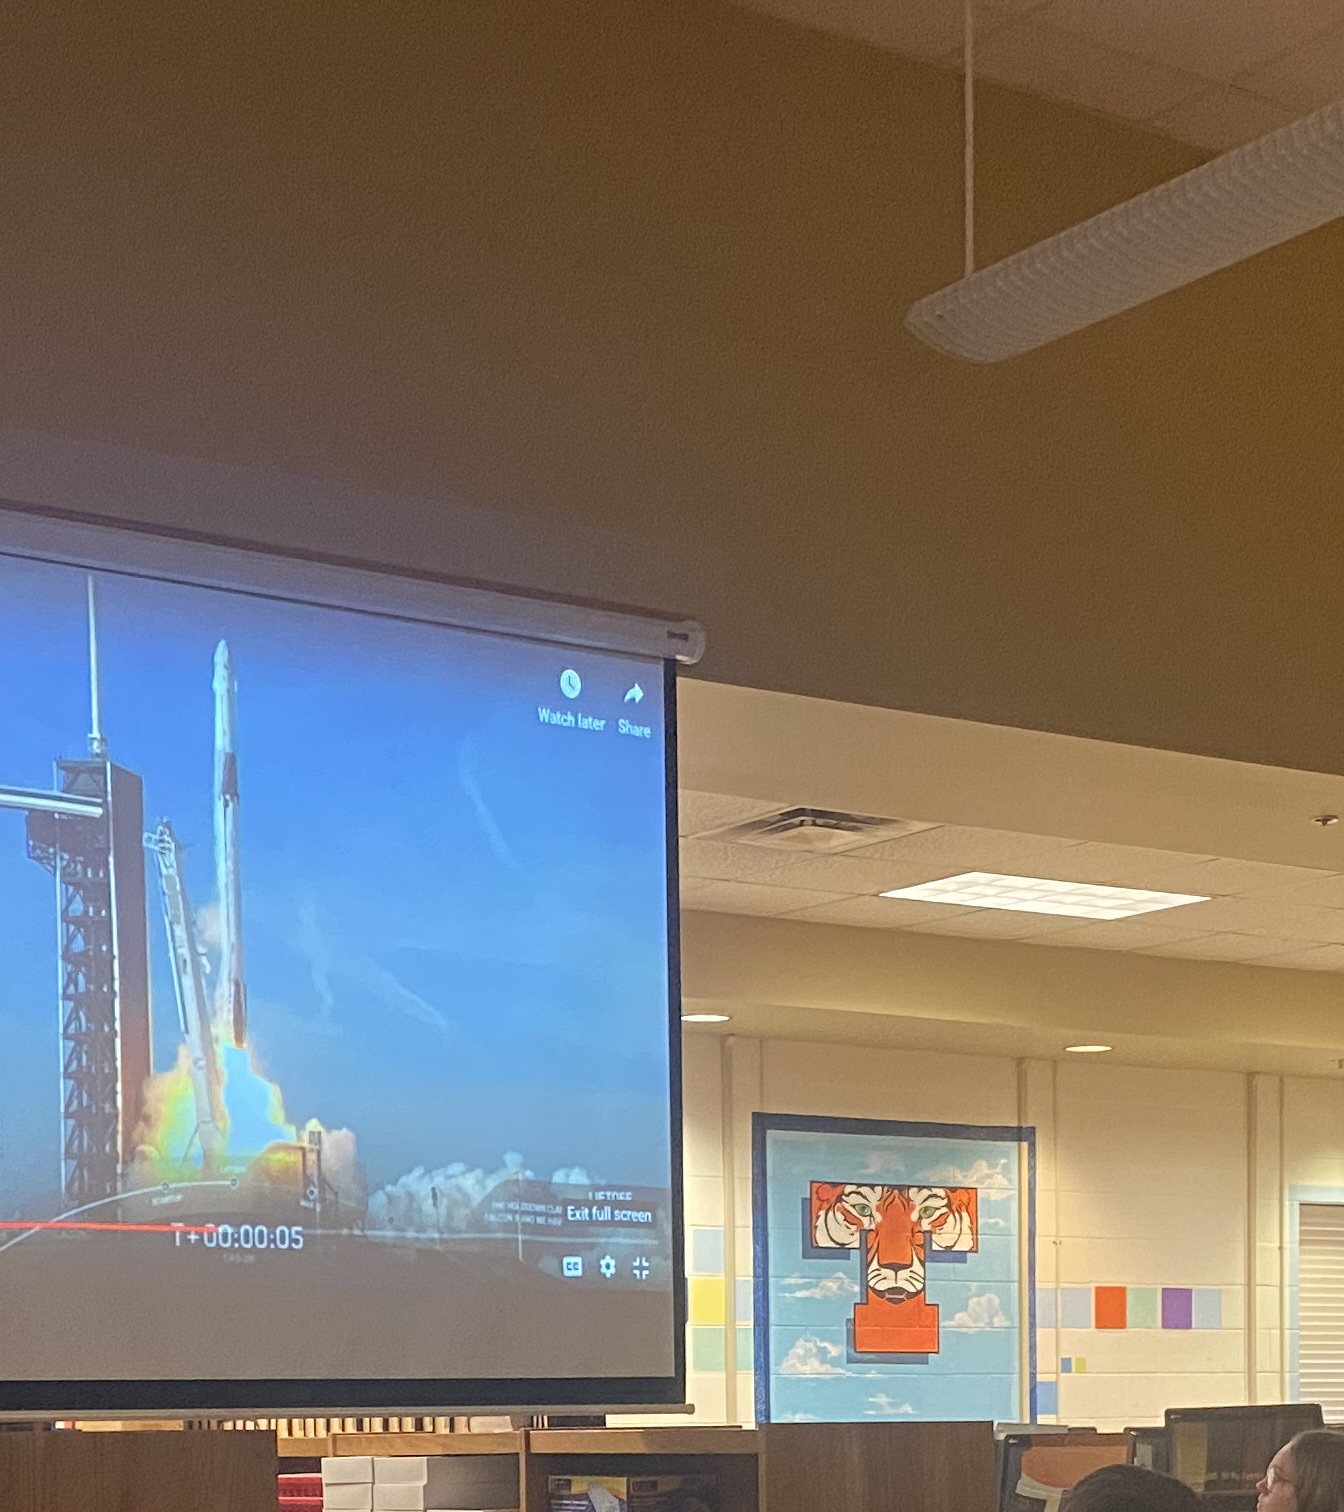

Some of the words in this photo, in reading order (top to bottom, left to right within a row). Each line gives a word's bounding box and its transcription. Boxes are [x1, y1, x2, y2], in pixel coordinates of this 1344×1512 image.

[538, 707, 575, 728] Watch
[577, 712, 606, 731] later
[617, 718, 651, 738] Share
[567, 1205, 590, 1221] Exit
[592, 1205, 611, 1221] full
[614, 1209, 652, 1223] screen
